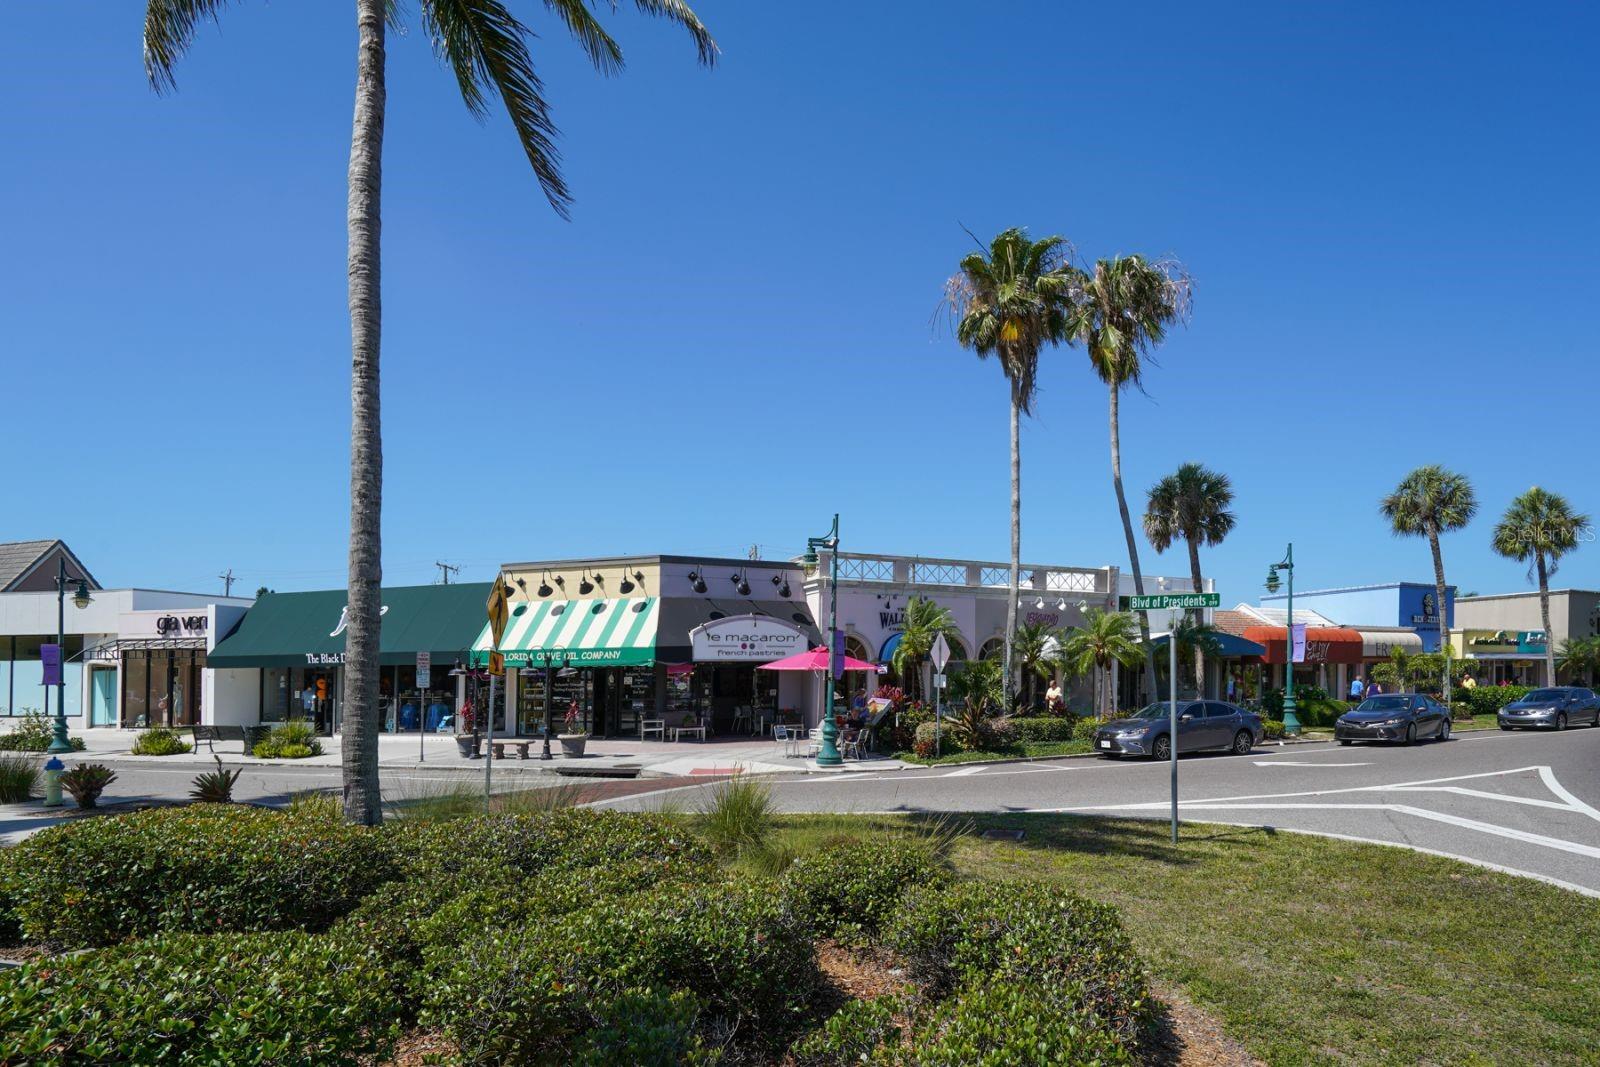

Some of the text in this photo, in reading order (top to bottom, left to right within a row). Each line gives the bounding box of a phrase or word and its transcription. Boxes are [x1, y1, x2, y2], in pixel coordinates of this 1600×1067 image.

[1131, 597, 1150, 609] Blvd
[1152, 597, 1161, 608] of
[1163, 595, 1207, 607] Presidents
[156, 614, 179, 635] gia
[725, 634, 796, 642] macaron
[305, 652, 320, 664] The
[321, 652, 340, 664] Black
[503, 652, 533, 661] LORIDA
[581, 651, 621, 660] COMPANY
